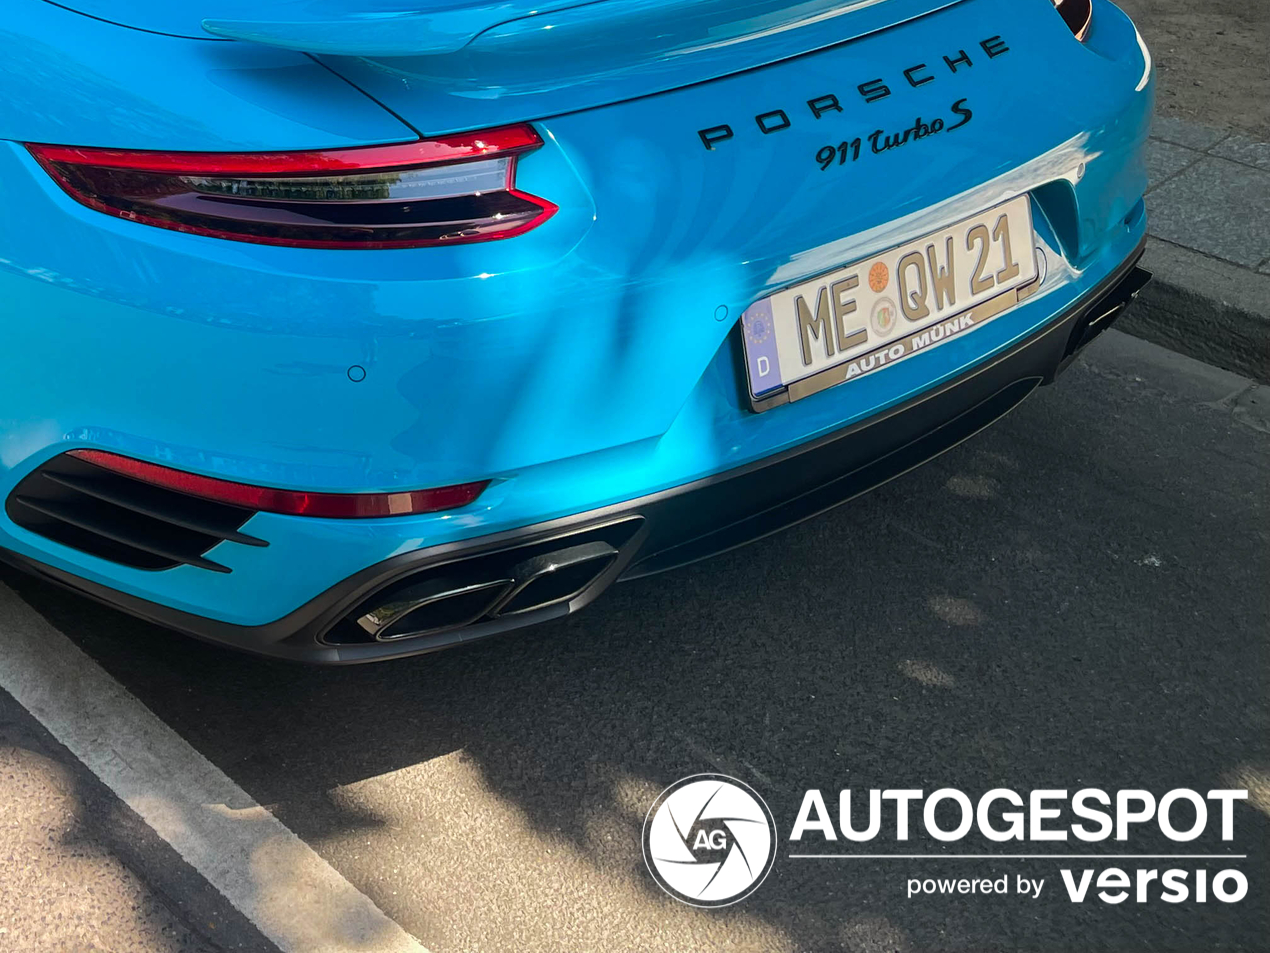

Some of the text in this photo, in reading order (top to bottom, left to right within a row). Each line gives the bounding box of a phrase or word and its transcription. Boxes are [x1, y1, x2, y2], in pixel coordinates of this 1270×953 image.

[697, 35, 1010, 151] PORSCHE
[815, 138, 861, 171] 911
[946, 98, 972, 132] S
[794, 213, 1020, 366] ME QW 21
[757, 355, 770, 378] D
[845, 312, 975, 380] AUTO MÜNK
